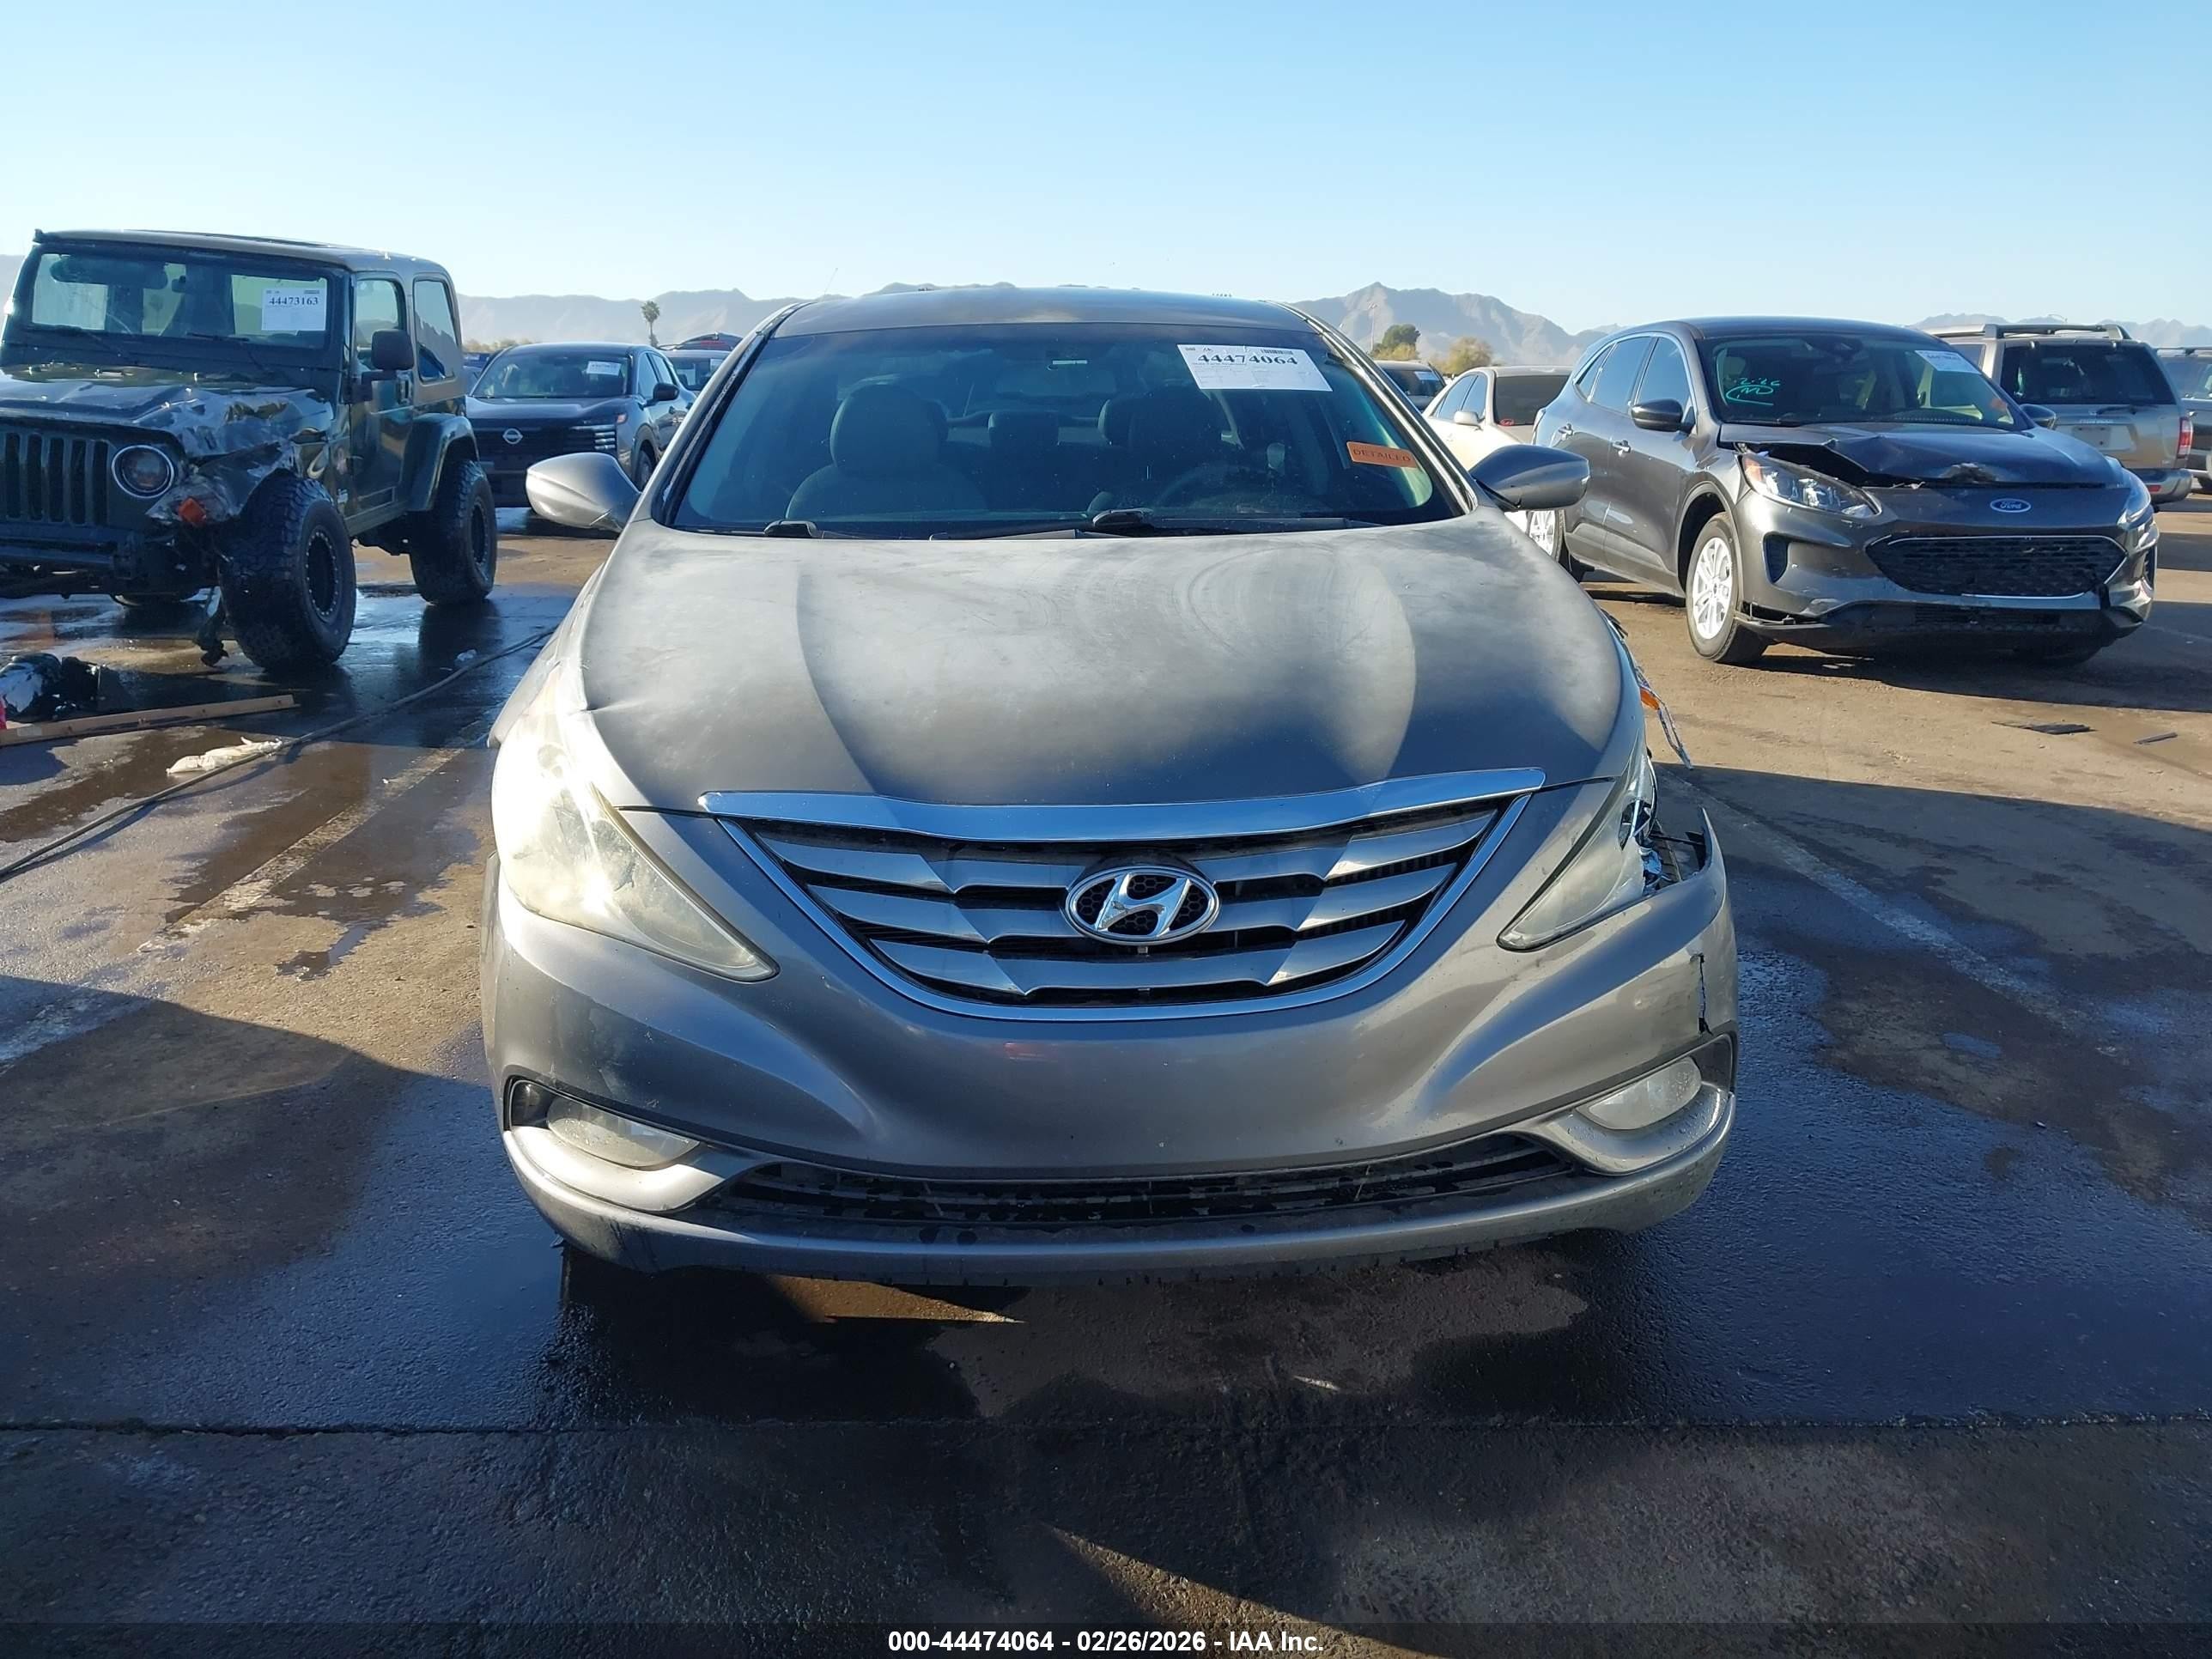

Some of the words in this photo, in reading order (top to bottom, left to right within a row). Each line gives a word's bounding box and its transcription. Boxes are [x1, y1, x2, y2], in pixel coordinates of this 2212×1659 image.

[269, 296, 319, 306] 44473163
[1197, 353, 1298, 365] 44474064
[1352, 448, 1411, 461] DETAILED
[1999, 501, 2021, 509] Ford
